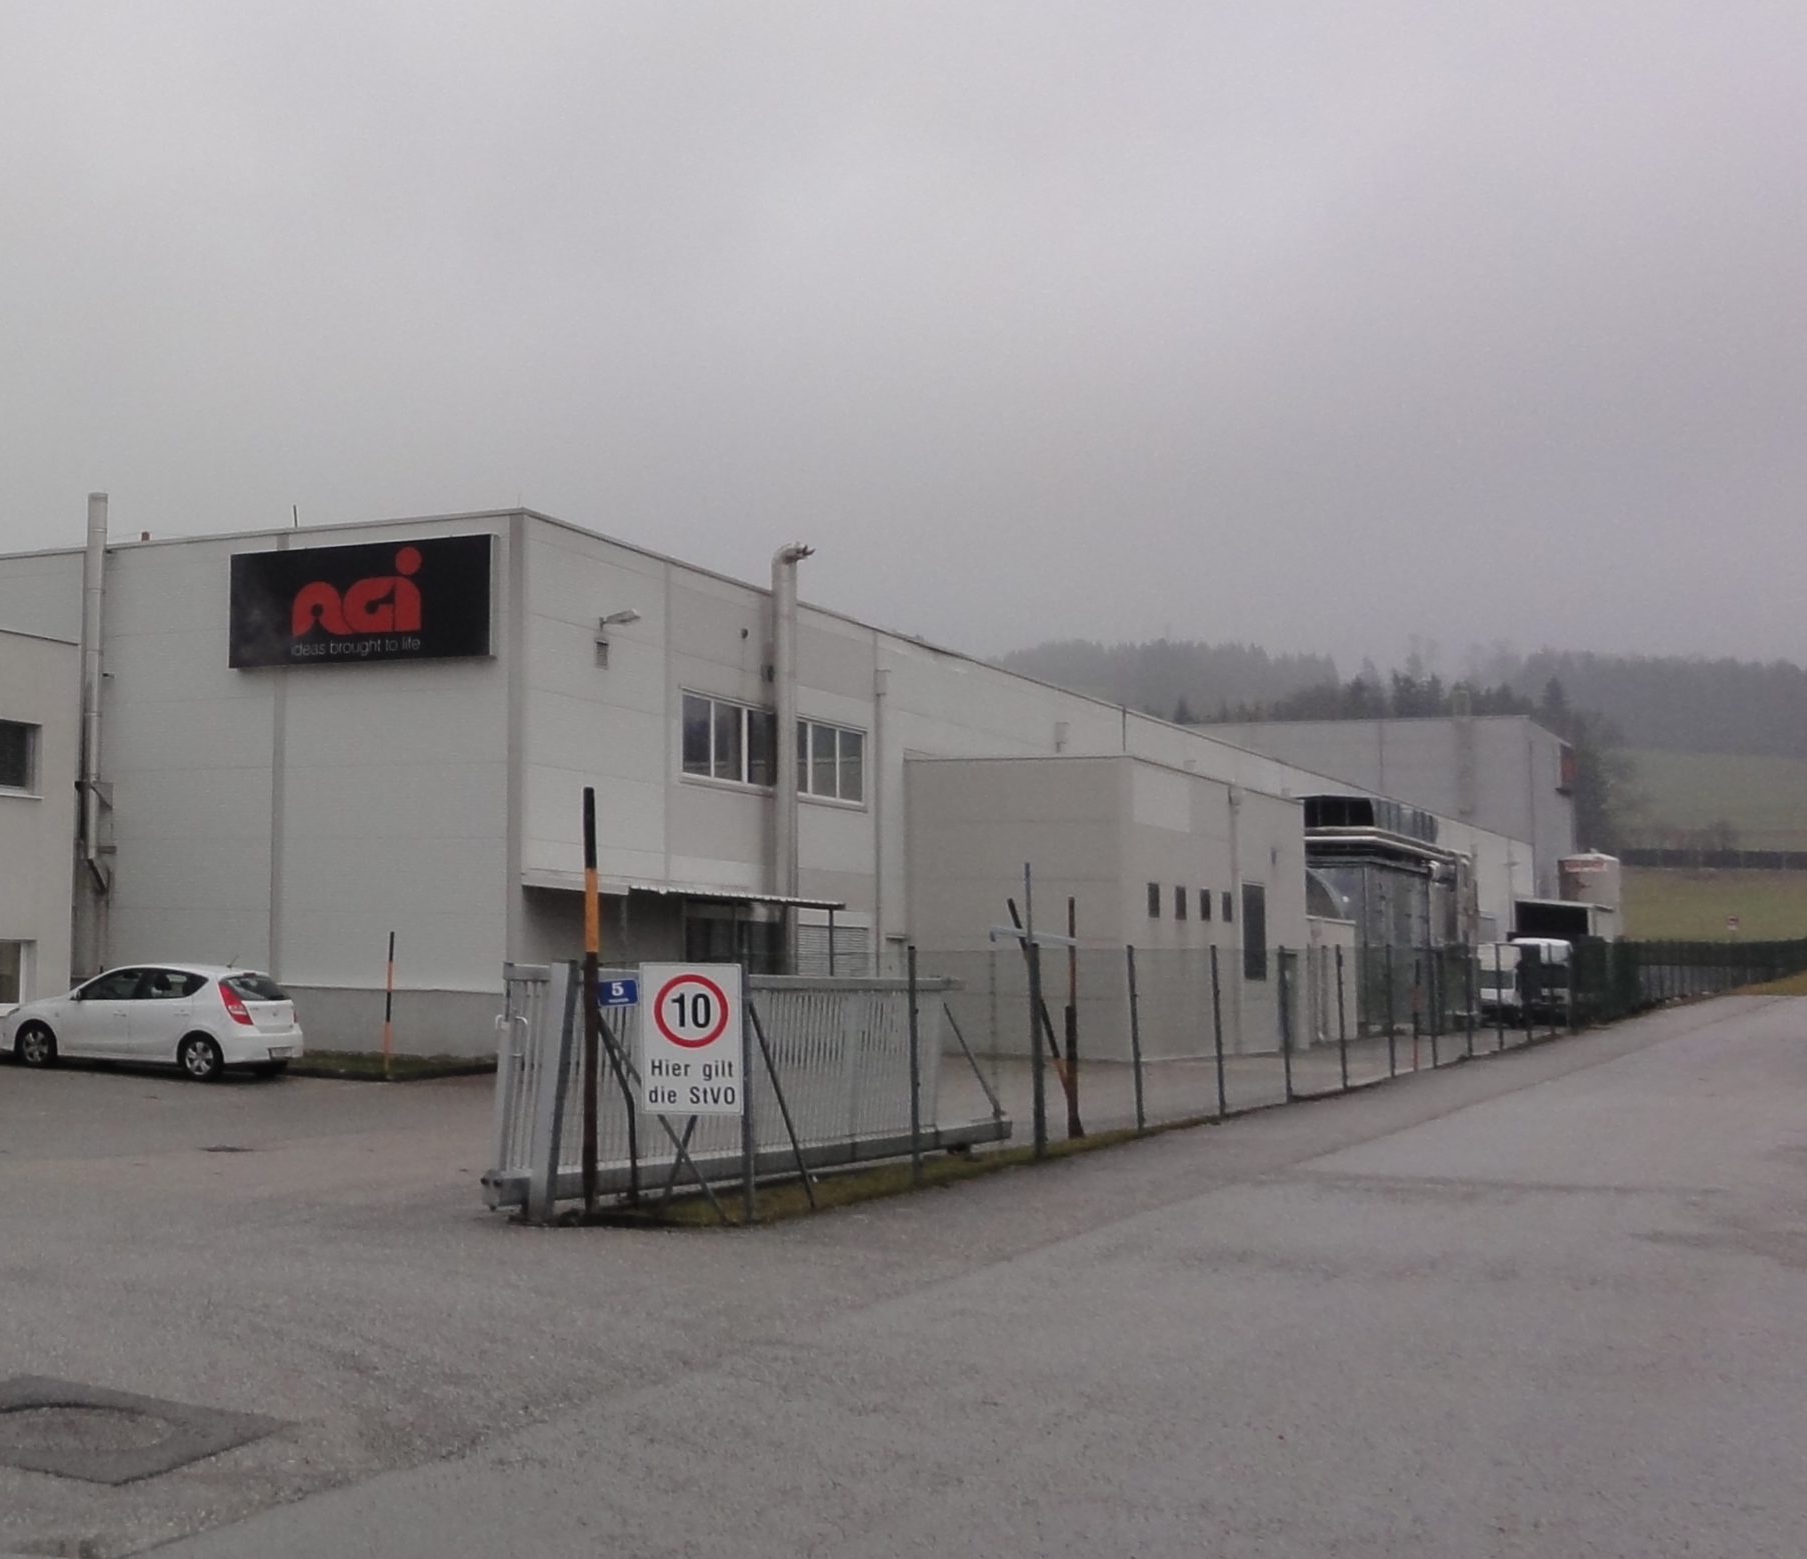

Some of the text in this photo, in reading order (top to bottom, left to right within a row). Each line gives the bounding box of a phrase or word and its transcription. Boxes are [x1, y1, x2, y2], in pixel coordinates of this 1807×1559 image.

[291, 636, 421, 657] ideas brought to life
[611, 982, 624, 997] 5
[671, 992, 711, 1029] 10
[650, 1059, 734, 1081] Hier gilt
[648, 1086, 736, 1105] die StVO
